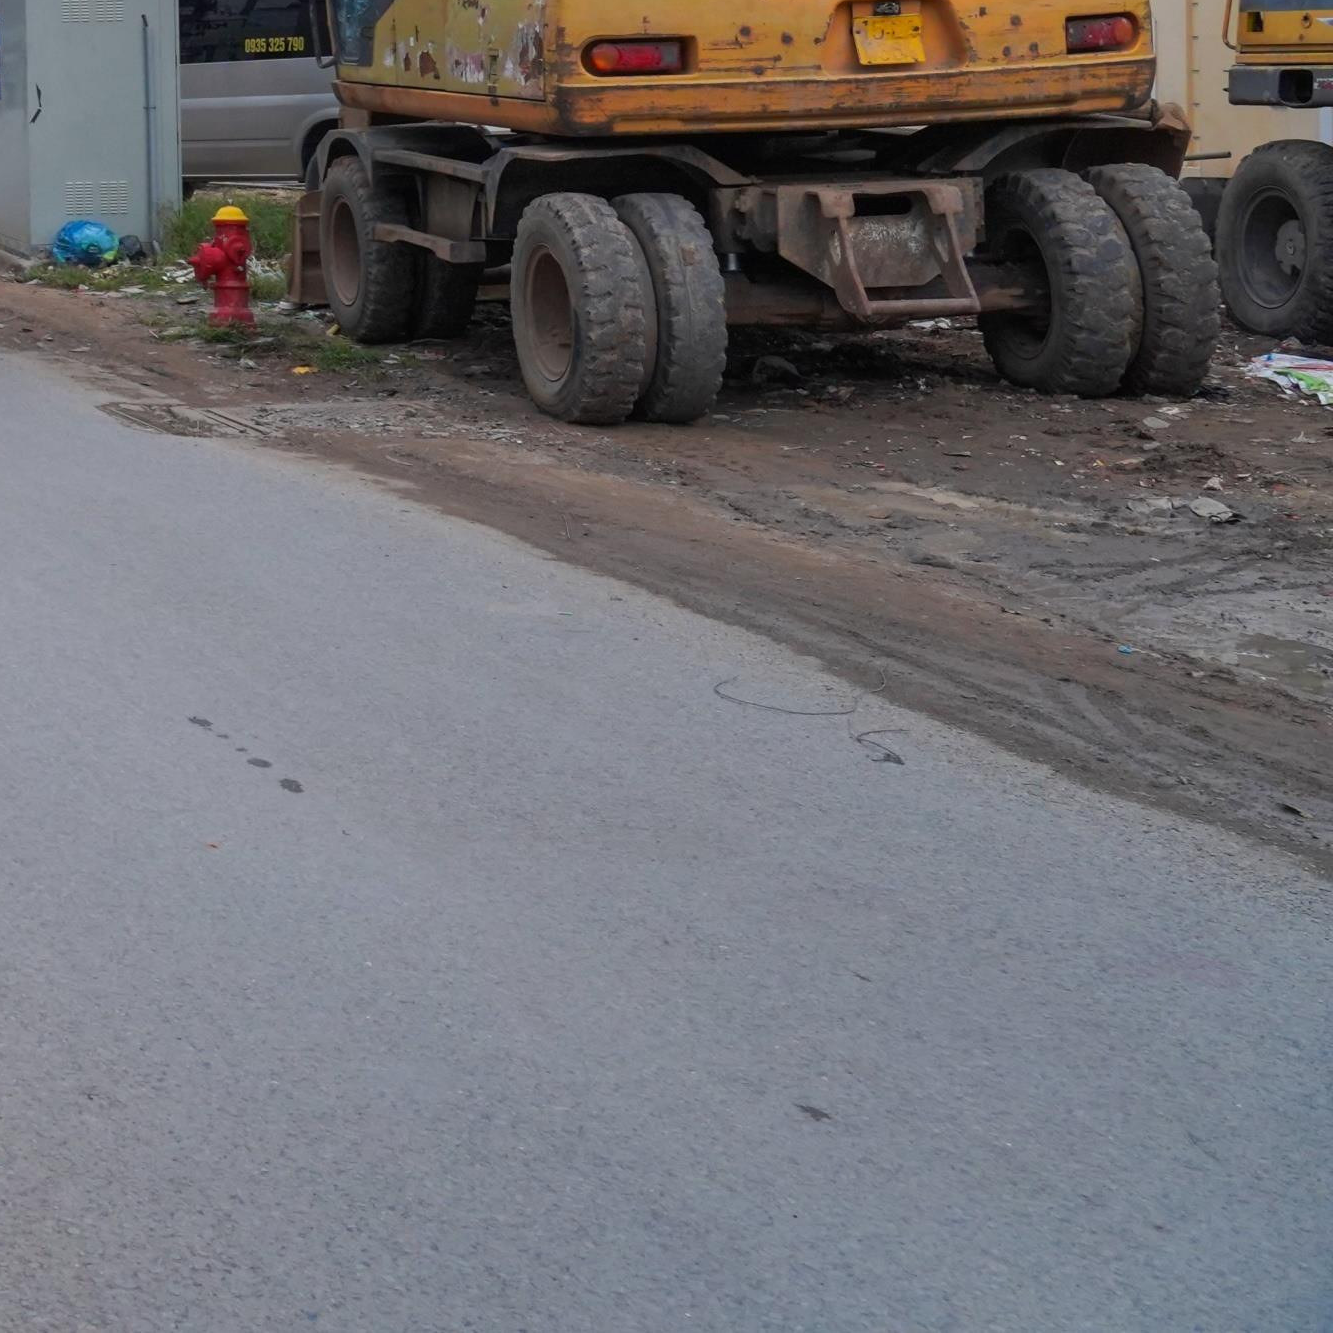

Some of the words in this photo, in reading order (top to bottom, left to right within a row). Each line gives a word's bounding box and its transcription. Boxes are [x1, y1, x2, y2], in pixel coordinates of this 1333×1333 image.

[244, 37, 267, 53] 0935
[268, 37, 286, 53] 325
[287, 36, 305, 52] 790
